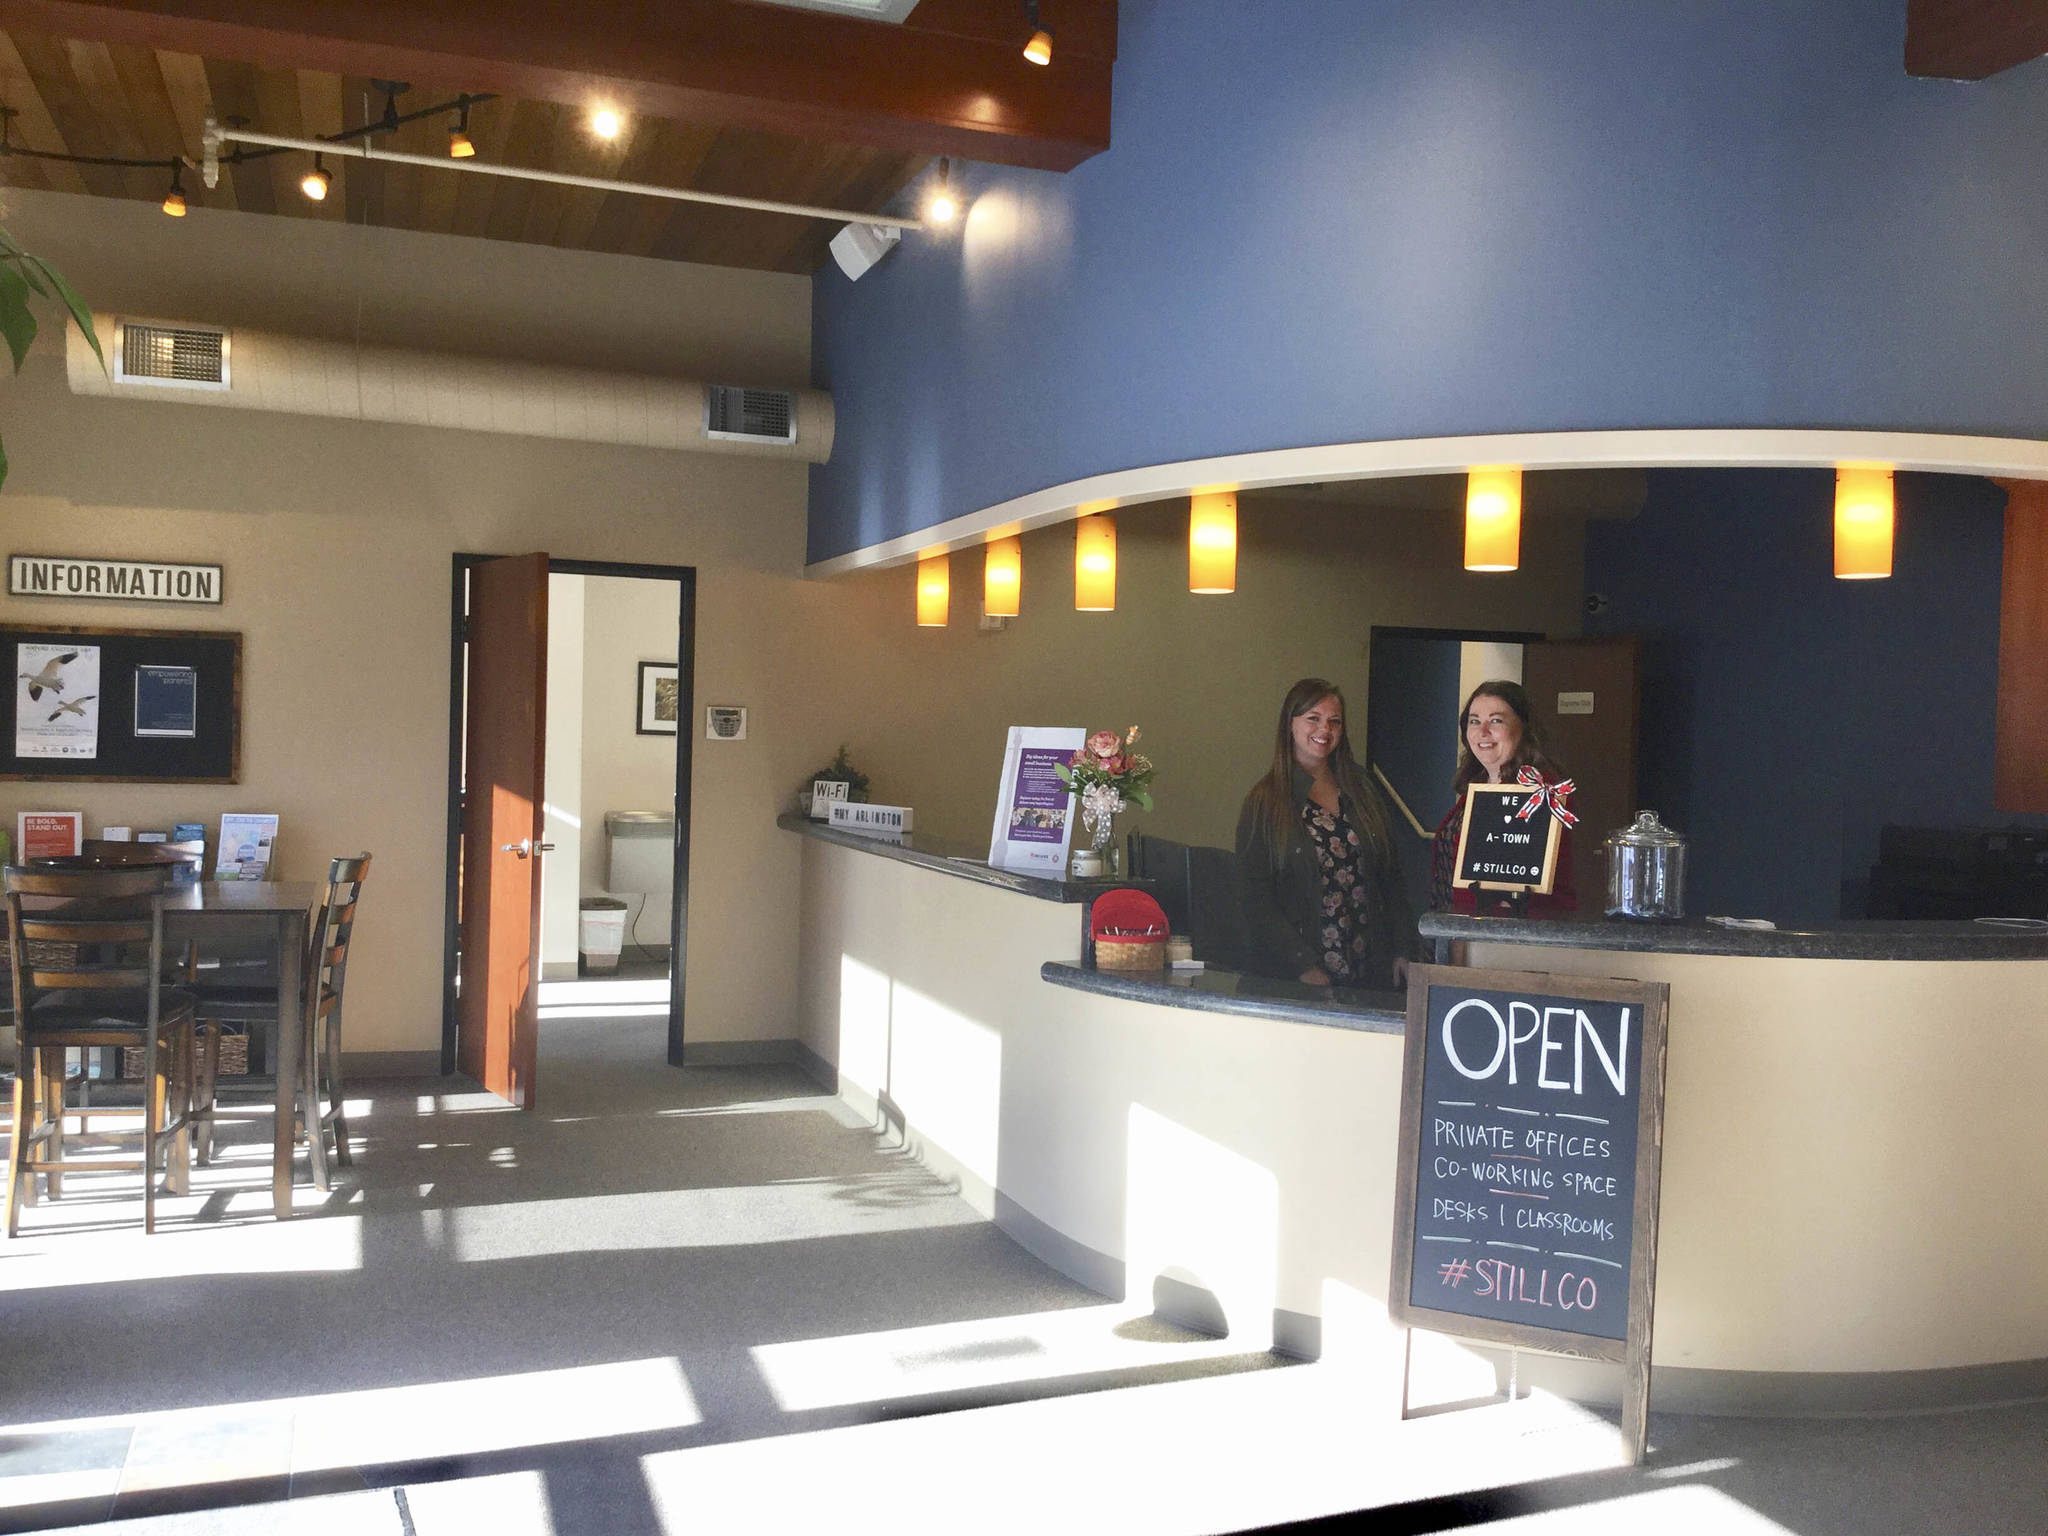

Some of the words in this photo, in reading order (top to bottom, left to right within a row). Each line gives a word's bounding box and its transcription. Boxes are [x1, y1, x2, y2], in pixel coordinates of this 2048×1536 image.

[20, 562, 212, 599] INFORMATION
[816, 782, 847, 799] Wi-Fi
[1502, 796, 1519, 806] WE
[834, 808, 850, 820] #MY
[855, 809, 902, 826] ARLINGTON
[1442, 998, 1630, 1096] OPEN
[1434, 1118, 1514, 1150] PRIVATE
[1525, 1129, 1611, 1158] OFFICES
[1434, 1156, 1554, 1189] CO-WORKING
[1562, 1173, 1617, 1197] SPACE
[1433, 1198, 1489, 1222] DESKS
[1516, 1208, 1615, 1241] CLASSROOMS
[1437, 1257, 1598, 1311] #STILLCO
